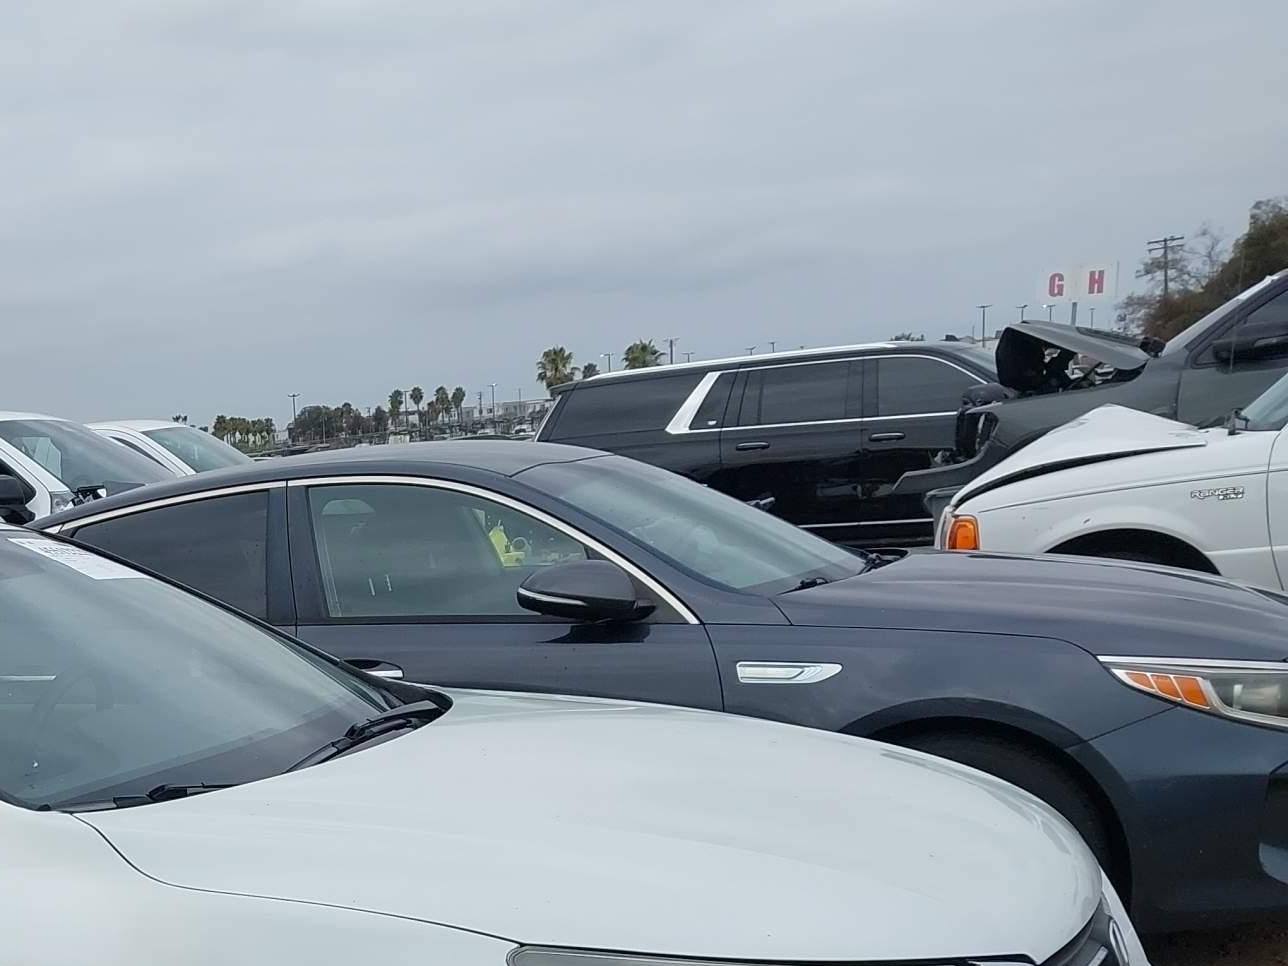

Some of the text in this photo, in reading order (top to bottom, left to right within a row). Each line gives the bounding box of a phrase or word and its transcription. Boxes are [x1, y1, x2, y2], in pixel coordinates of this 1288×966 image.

[1049, 270, 1104, 297] G H
[1191, 487, 1244, 499] RANGER
